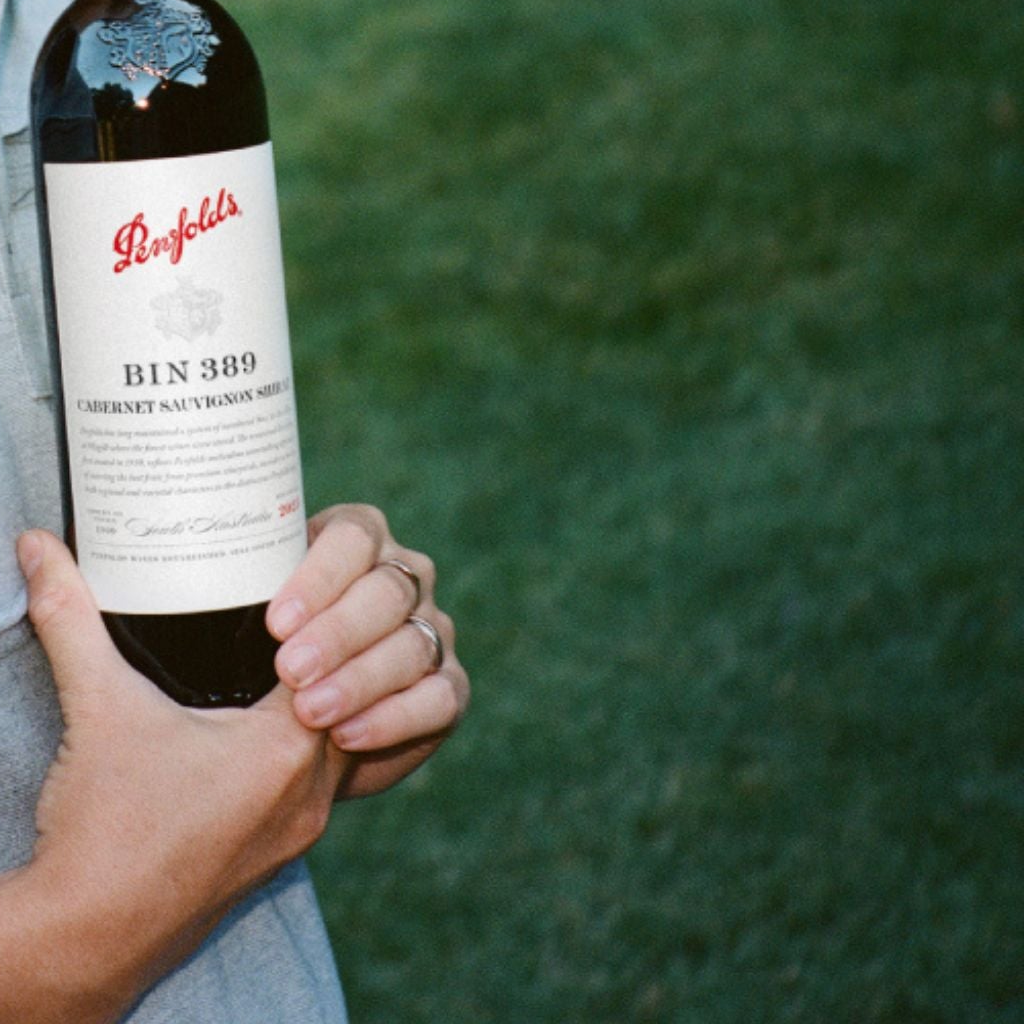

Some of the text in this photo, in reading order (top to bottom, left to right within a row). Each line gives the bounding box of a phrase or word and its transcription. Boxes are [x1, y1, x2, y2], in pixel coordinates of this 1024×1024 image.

[113, 187, 239, 274] Penfolds
[123, 351, 257, 387] BIN 389
[77, 398, 155, 414] CABERNET
[159, 387, 253, 413] SAUVIGNON
